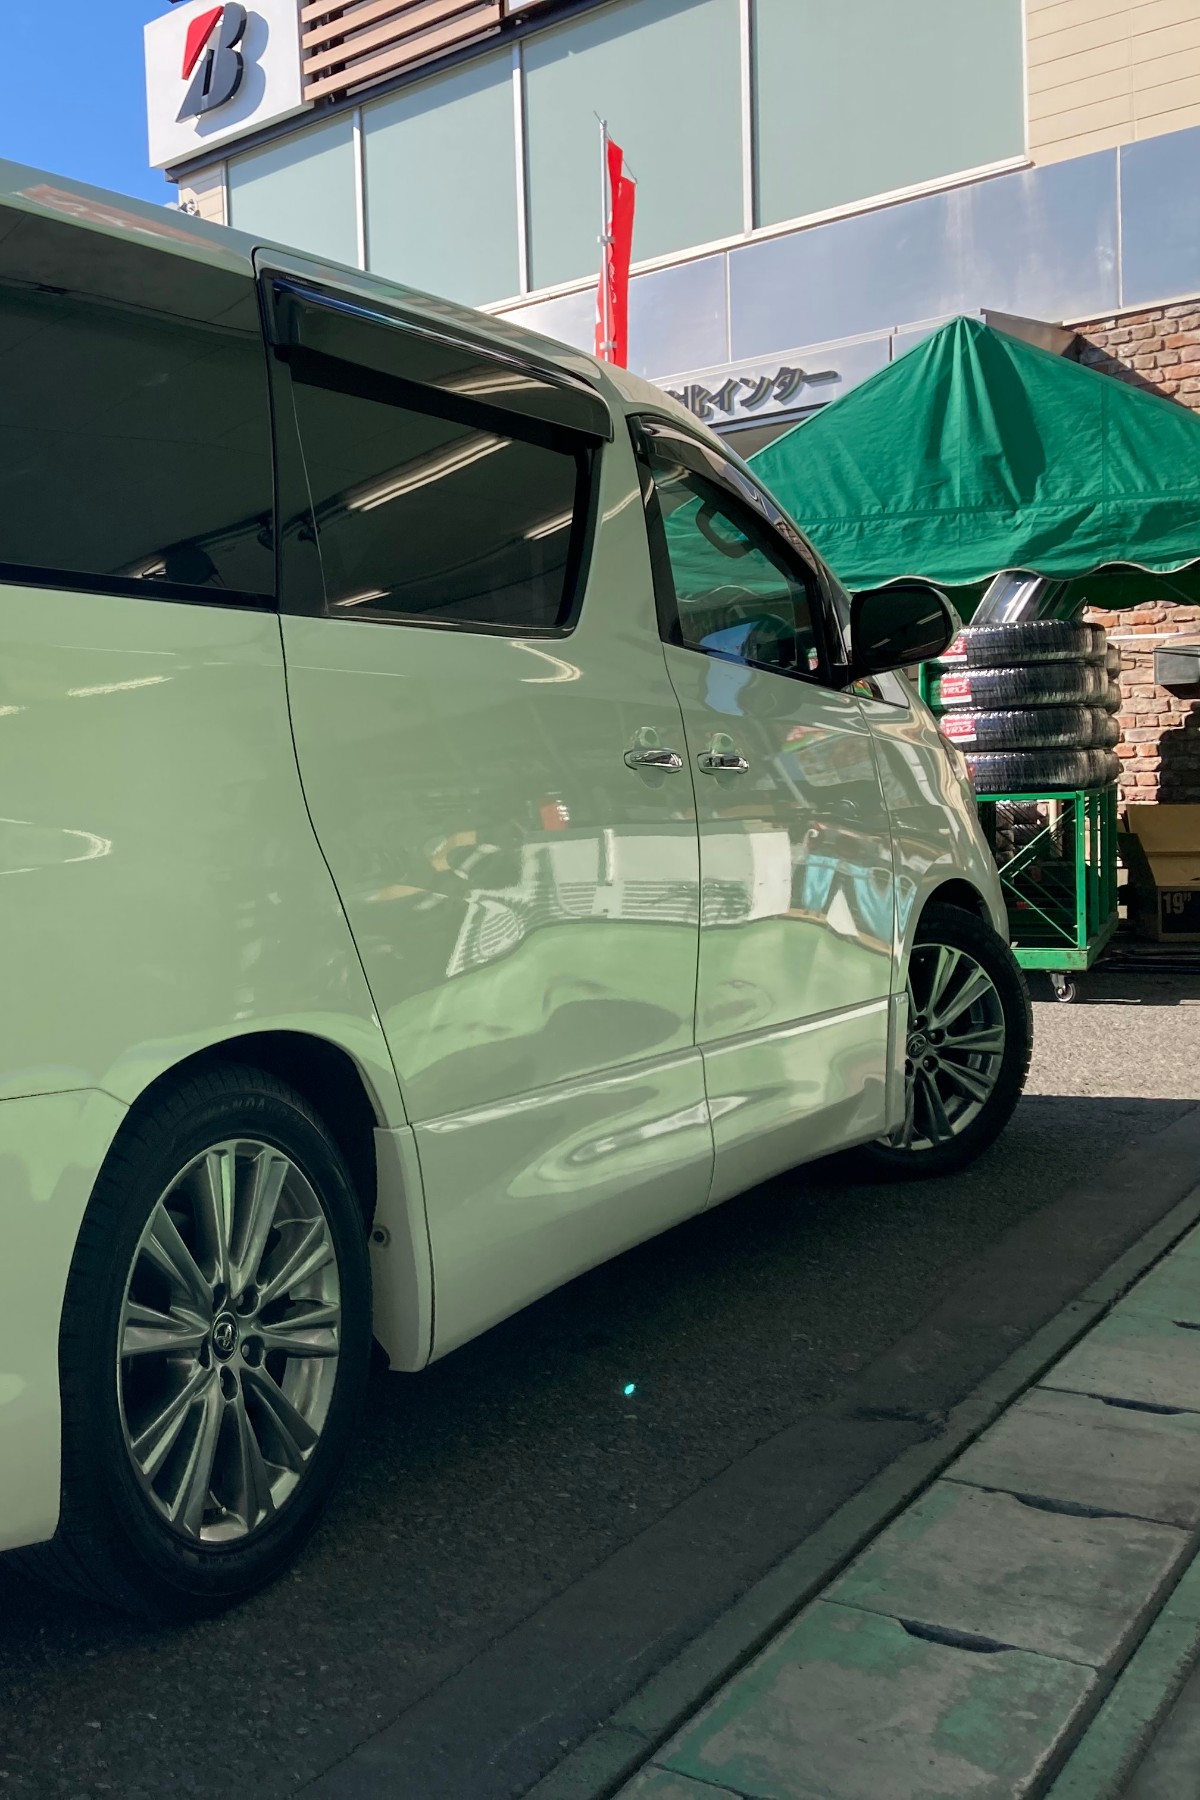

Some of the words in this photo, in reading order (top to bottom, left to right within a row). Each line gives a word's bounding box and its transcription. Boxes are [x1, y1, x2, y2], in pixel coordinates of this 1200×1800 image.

[664, 366, 838, 418] 北インター
[946, 724, 972, 735] VRX2
